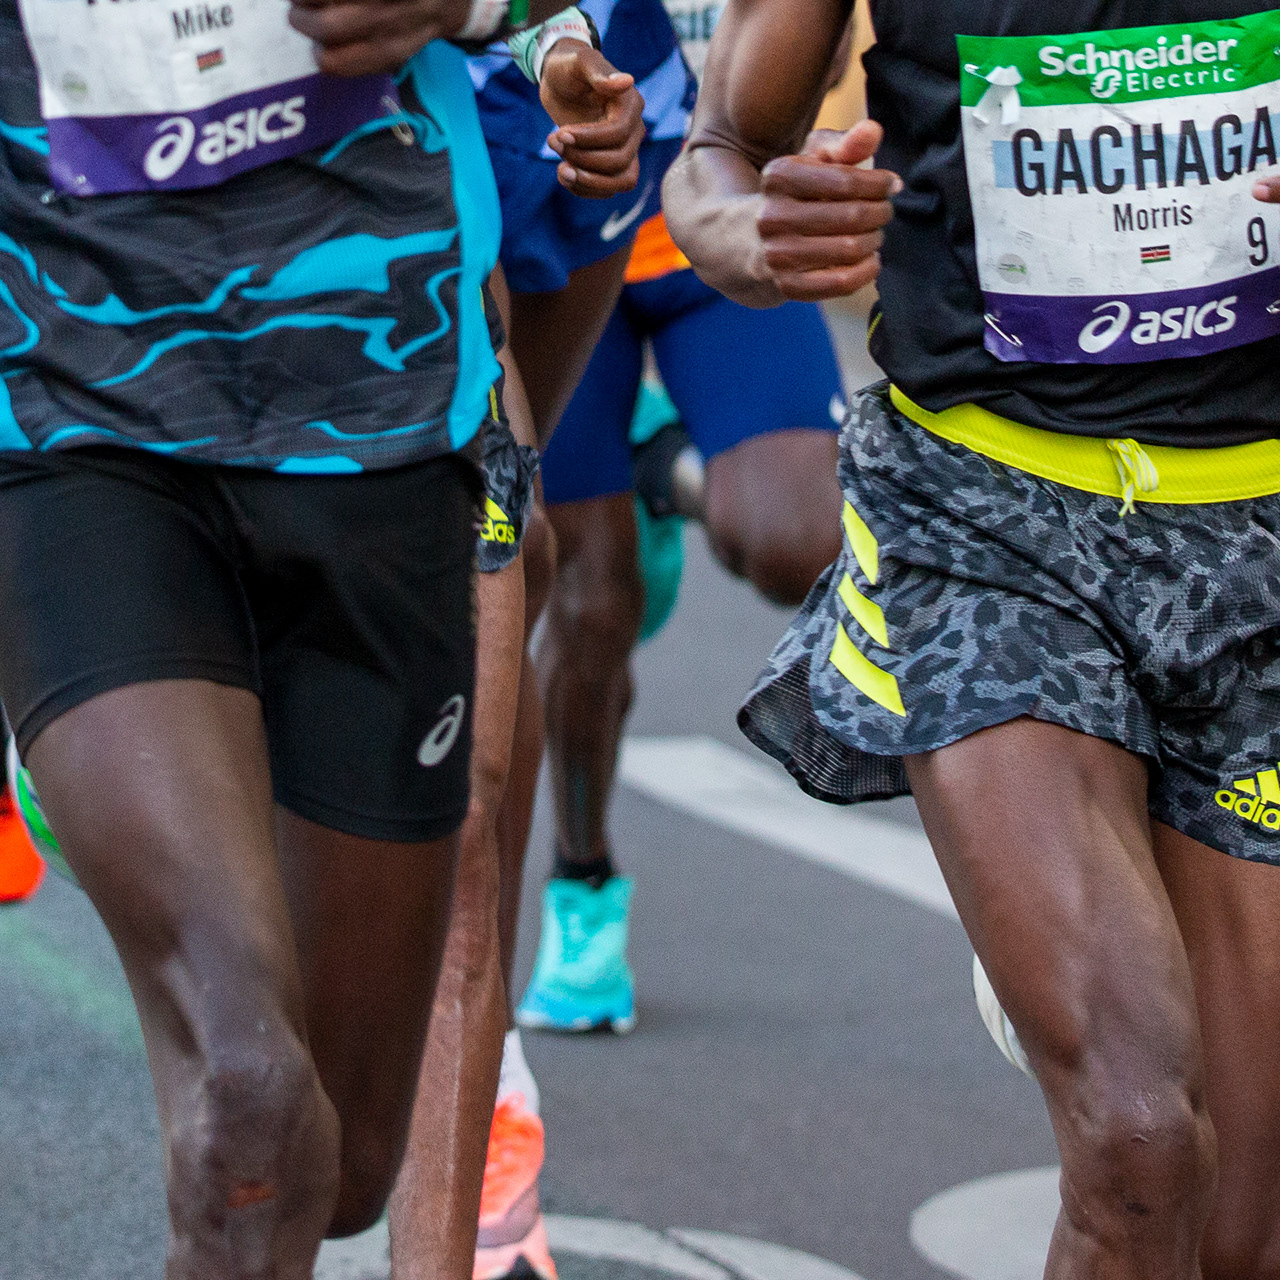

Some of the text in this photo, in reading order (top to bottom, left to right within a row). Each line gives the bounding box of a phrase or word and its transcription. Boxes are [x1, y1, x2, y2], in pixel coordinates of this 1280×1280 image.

[173, 4, 234, 40] Mike
[1038, 34, 1238, 77] Schneider
[1126, 65, 1237, 94] Electric
[195, 96, 307, 166] asics
[1011, 106, 1278, 197] GACHAGA
[1113, 200, 1194, 232] Morris
[1247, 216, 1270, 267] 9
[1130, 295, 1238, 347] asics
